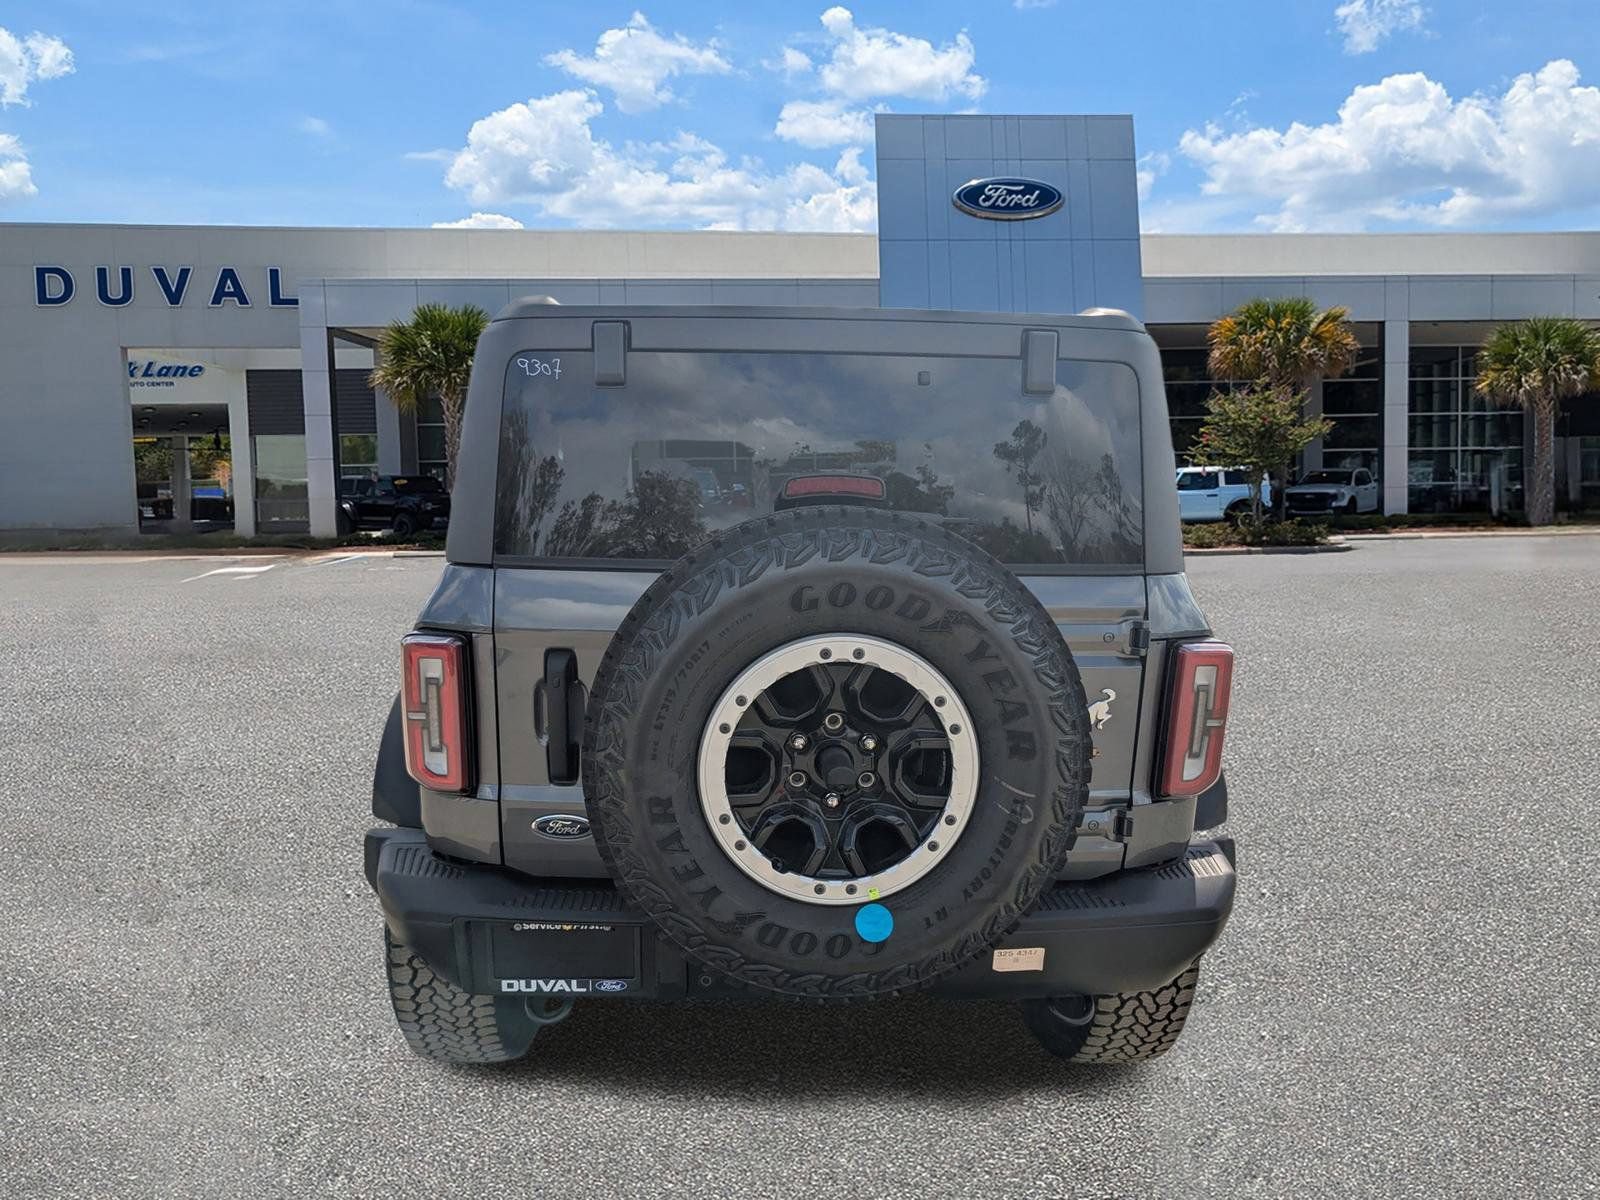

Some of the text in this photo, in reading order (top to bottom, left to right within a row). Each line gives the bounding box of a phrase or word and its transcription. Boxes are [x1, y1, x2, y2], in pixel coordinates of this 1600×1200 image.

[979, 184, 1040, 207] Ford
[34, 265, 300, 307] DUVAL
[141, 361, 205, 378] Lane
[516, 357, 562, 380] 9307
[546, 820, 582, 834] Ford
[501, 979, 587, 992] DUVAL
